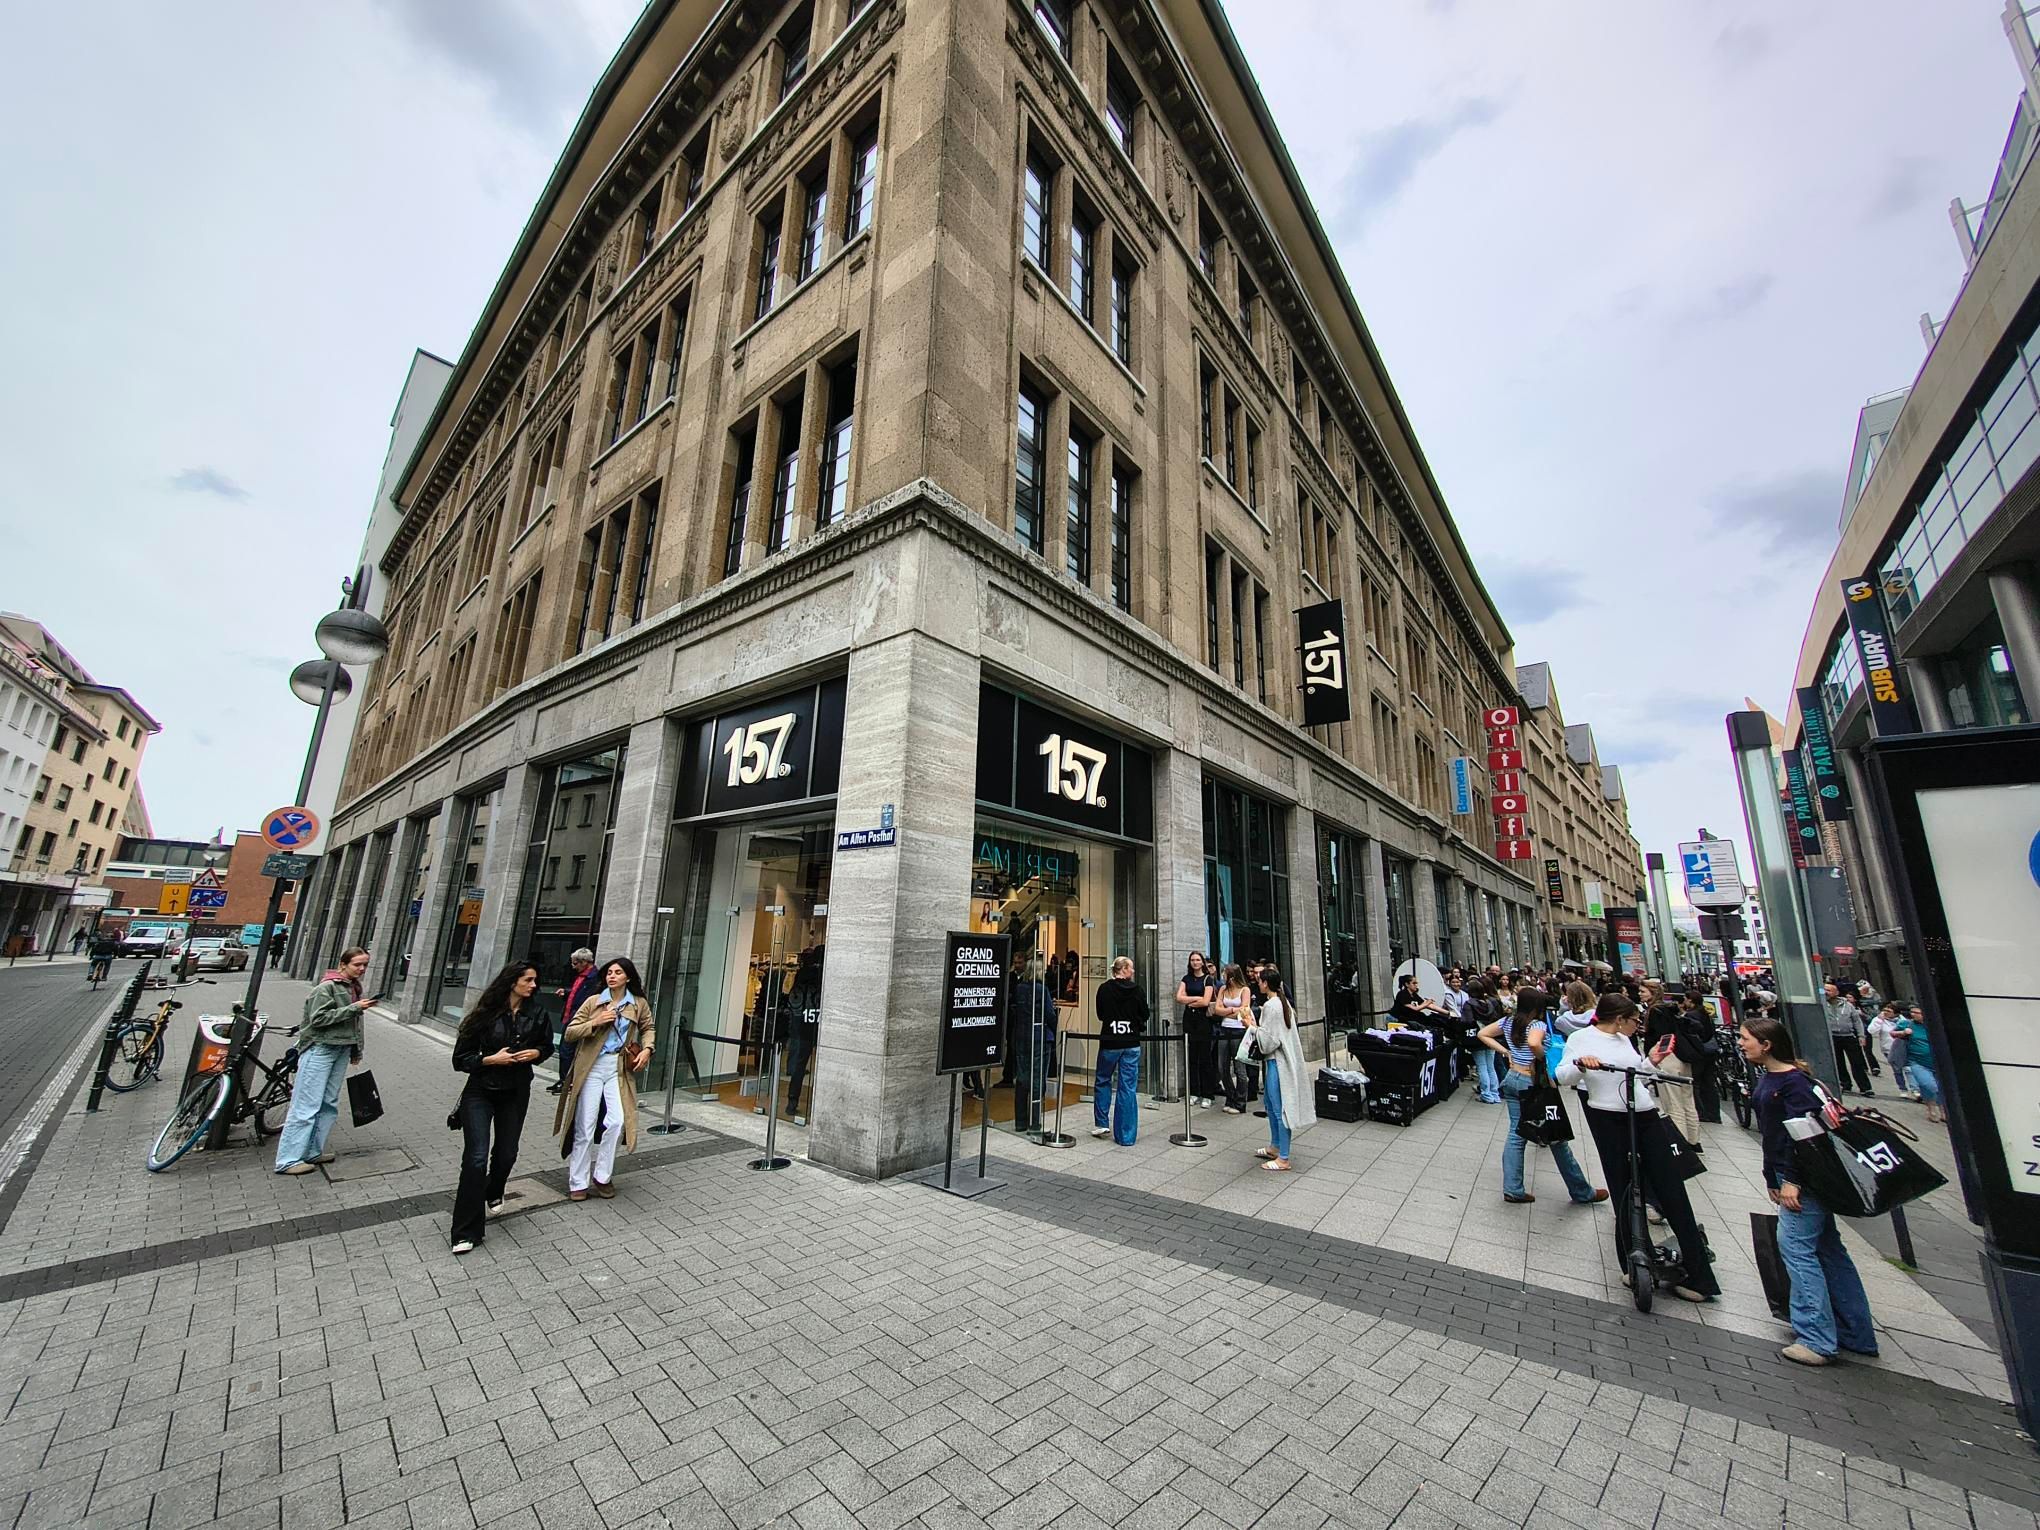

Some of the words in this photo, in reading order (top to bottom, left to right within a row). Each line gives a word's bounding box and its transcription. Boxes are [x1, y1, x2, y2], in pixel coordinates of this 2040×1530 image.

[1859, 629, 1899, 703] SUBWAY
[1803, 708, 1822, 744] KLINIK
[1811, 744, 1835, 776] PAN
[1454, 759, 1468, 813] Barmenia
[1793, 796, 1812, 820] PAN
[838, 834, 849, 846] Am
[850, 833, 867, 845] Alten
[868, 829, 894, 843] Posthof
[957, 947, 993, 960] GRAND
[956, 964, 1000, 976] OPENING
[954, 988, 996, 996] DONNERSTAG
[963, 998, 978, 1006] JUNI
[979, 997, 993, 1006] 15:07
[802, 1008, 821, 1023] 157
